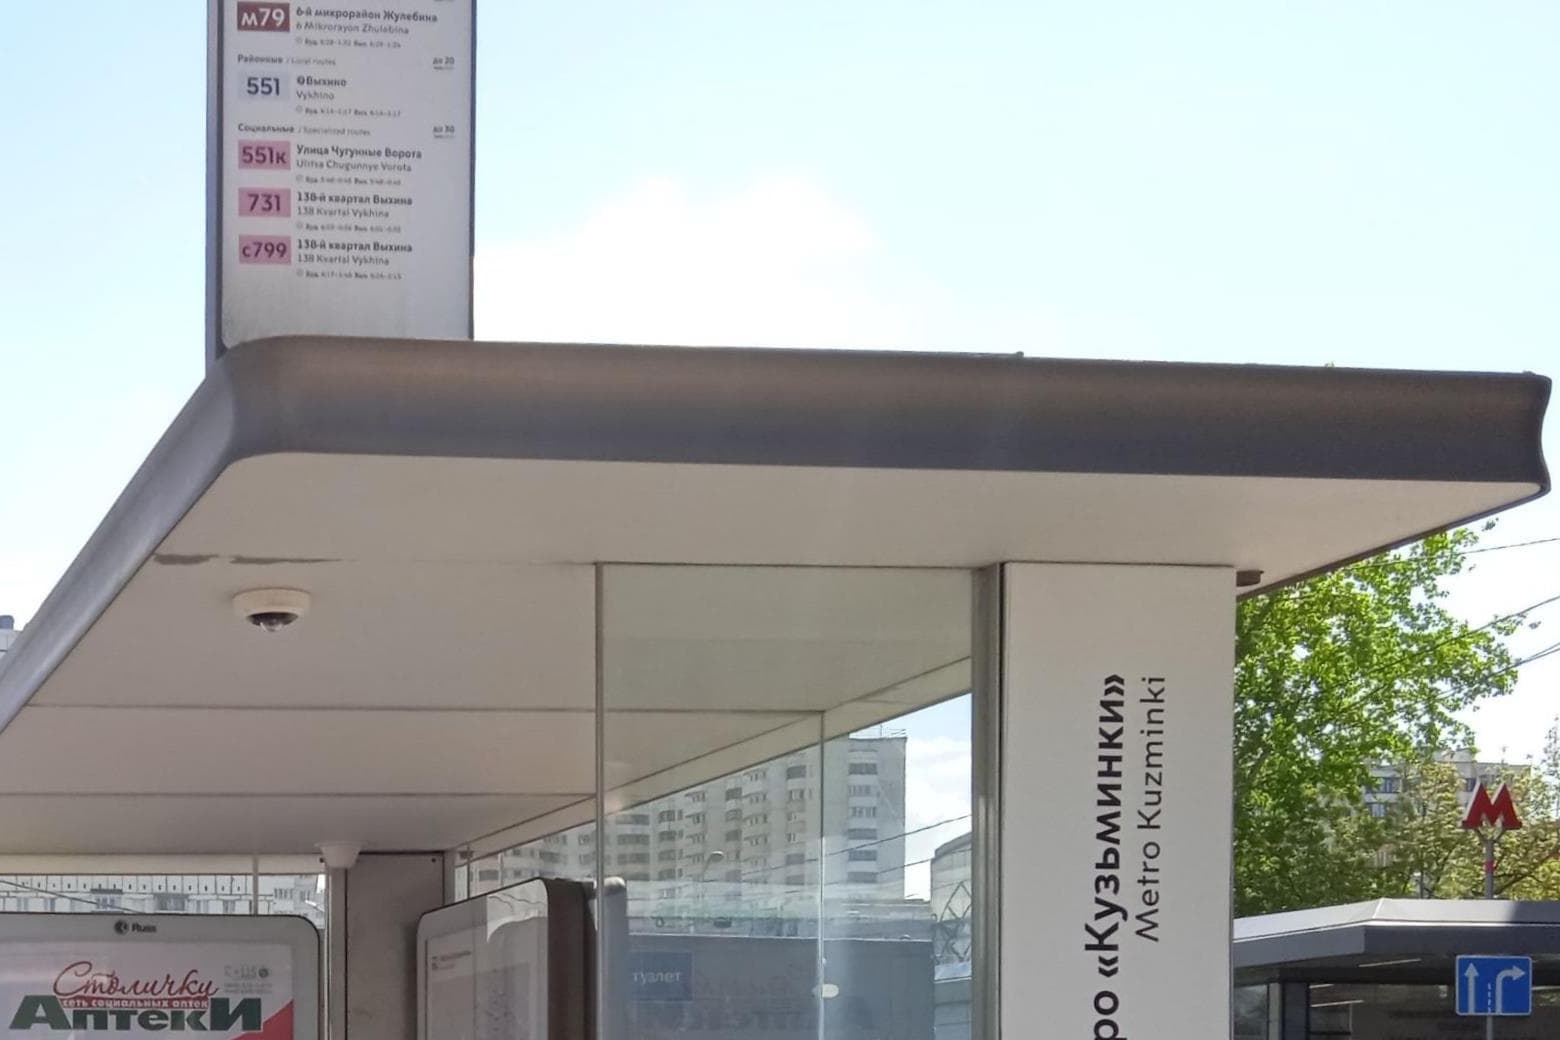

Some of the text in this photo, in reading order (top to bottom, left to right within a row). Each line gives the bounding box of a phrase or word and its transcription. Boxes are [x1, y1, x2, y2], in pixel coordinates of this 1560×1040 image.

[241, 7, 286, 26] м79
[296, 7, 438, 23] 6-й микрорайон Жулебина
[303, 23, 359, 35] Mikrorayon
[247, 77, 280, 96] 551
[306, 78, 347, 87] Выхино
[296, 90, 335, 101] Vykhino
[237, 124, 294, 135] Социальные
[242, 146, 287, 165] 551к
[296, 144, 422, 161] Улица Чугунные Ворота
[296, 160, 412, 174] Ulitsa Chugunnye Vorota
[247, 194, 281, 212] 731
[328, 195, 371, 206] квартал
[373, 195, 413, 206] Выхина
[316, 207, 350, 218] Kvartal
[352, 208, 390, 220] Vykhina
[242, 242, 287, 258] с799
[328, 243, 371, 254] квартал
[373, 242, 413, 253] Выхина
[316, 254, 350, 265] Kvartal
[352, 255, 390, 267] Vykhina
[1135, 676, 1166, 942] Metro Kuzminki
[1084, 673, 1128, 978] «Кузьминки»
[53, 961, 220, 998] Столички
[632, 970, 681, 984] туалет
[63, 999, 209, 1010] сеть социальных аптек
